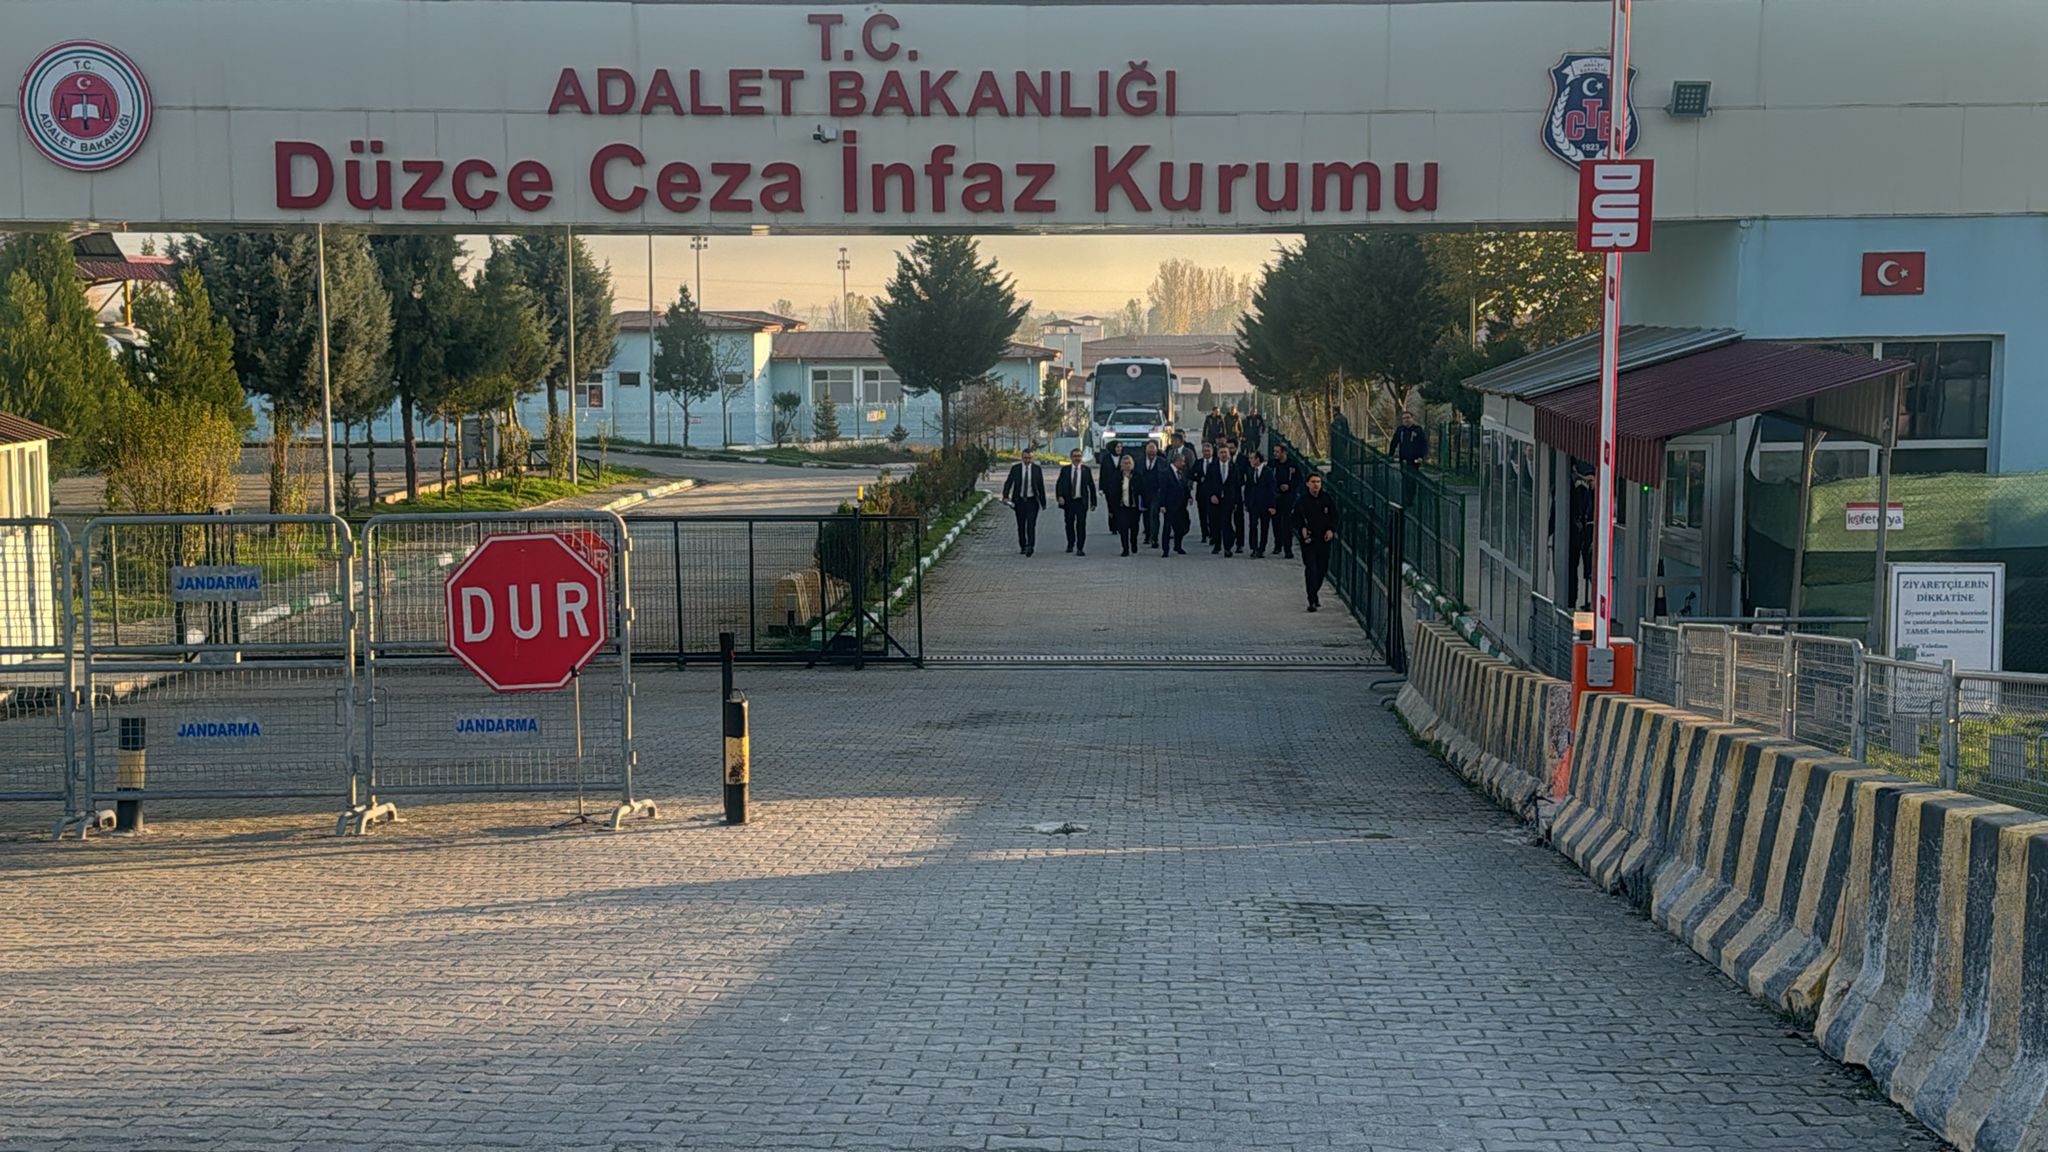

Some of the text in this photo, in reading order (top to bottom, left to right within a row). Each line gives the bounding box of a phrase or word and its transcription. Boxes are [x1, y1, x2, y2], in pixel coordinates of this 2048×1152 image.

[807, 13, 918, 61] T.C.
[73, 60, 95, 71] T.C.
[547, 60, 1176, 117] ADALET BAKANLIĞI
[39, 112, 76, 149] ADALET
[1581, 143, 1600, 151] 1923
[275, 129, 1439, 213] Düzce Ceza İnfaz Kurumu
[1591, 164, 1641, 248] DUR
[176, 576, 259, 591] JANDARMA
[1902, 580, 1989, 591] ZİYARETÇİLERİN
[1916, 592, 1976, 602] DİKKATİNE
[460, 581, 590, 643] DUR
[177, 722, 261, 737] JANDARMA
[456, 718, 538, 733] JANDARMA
